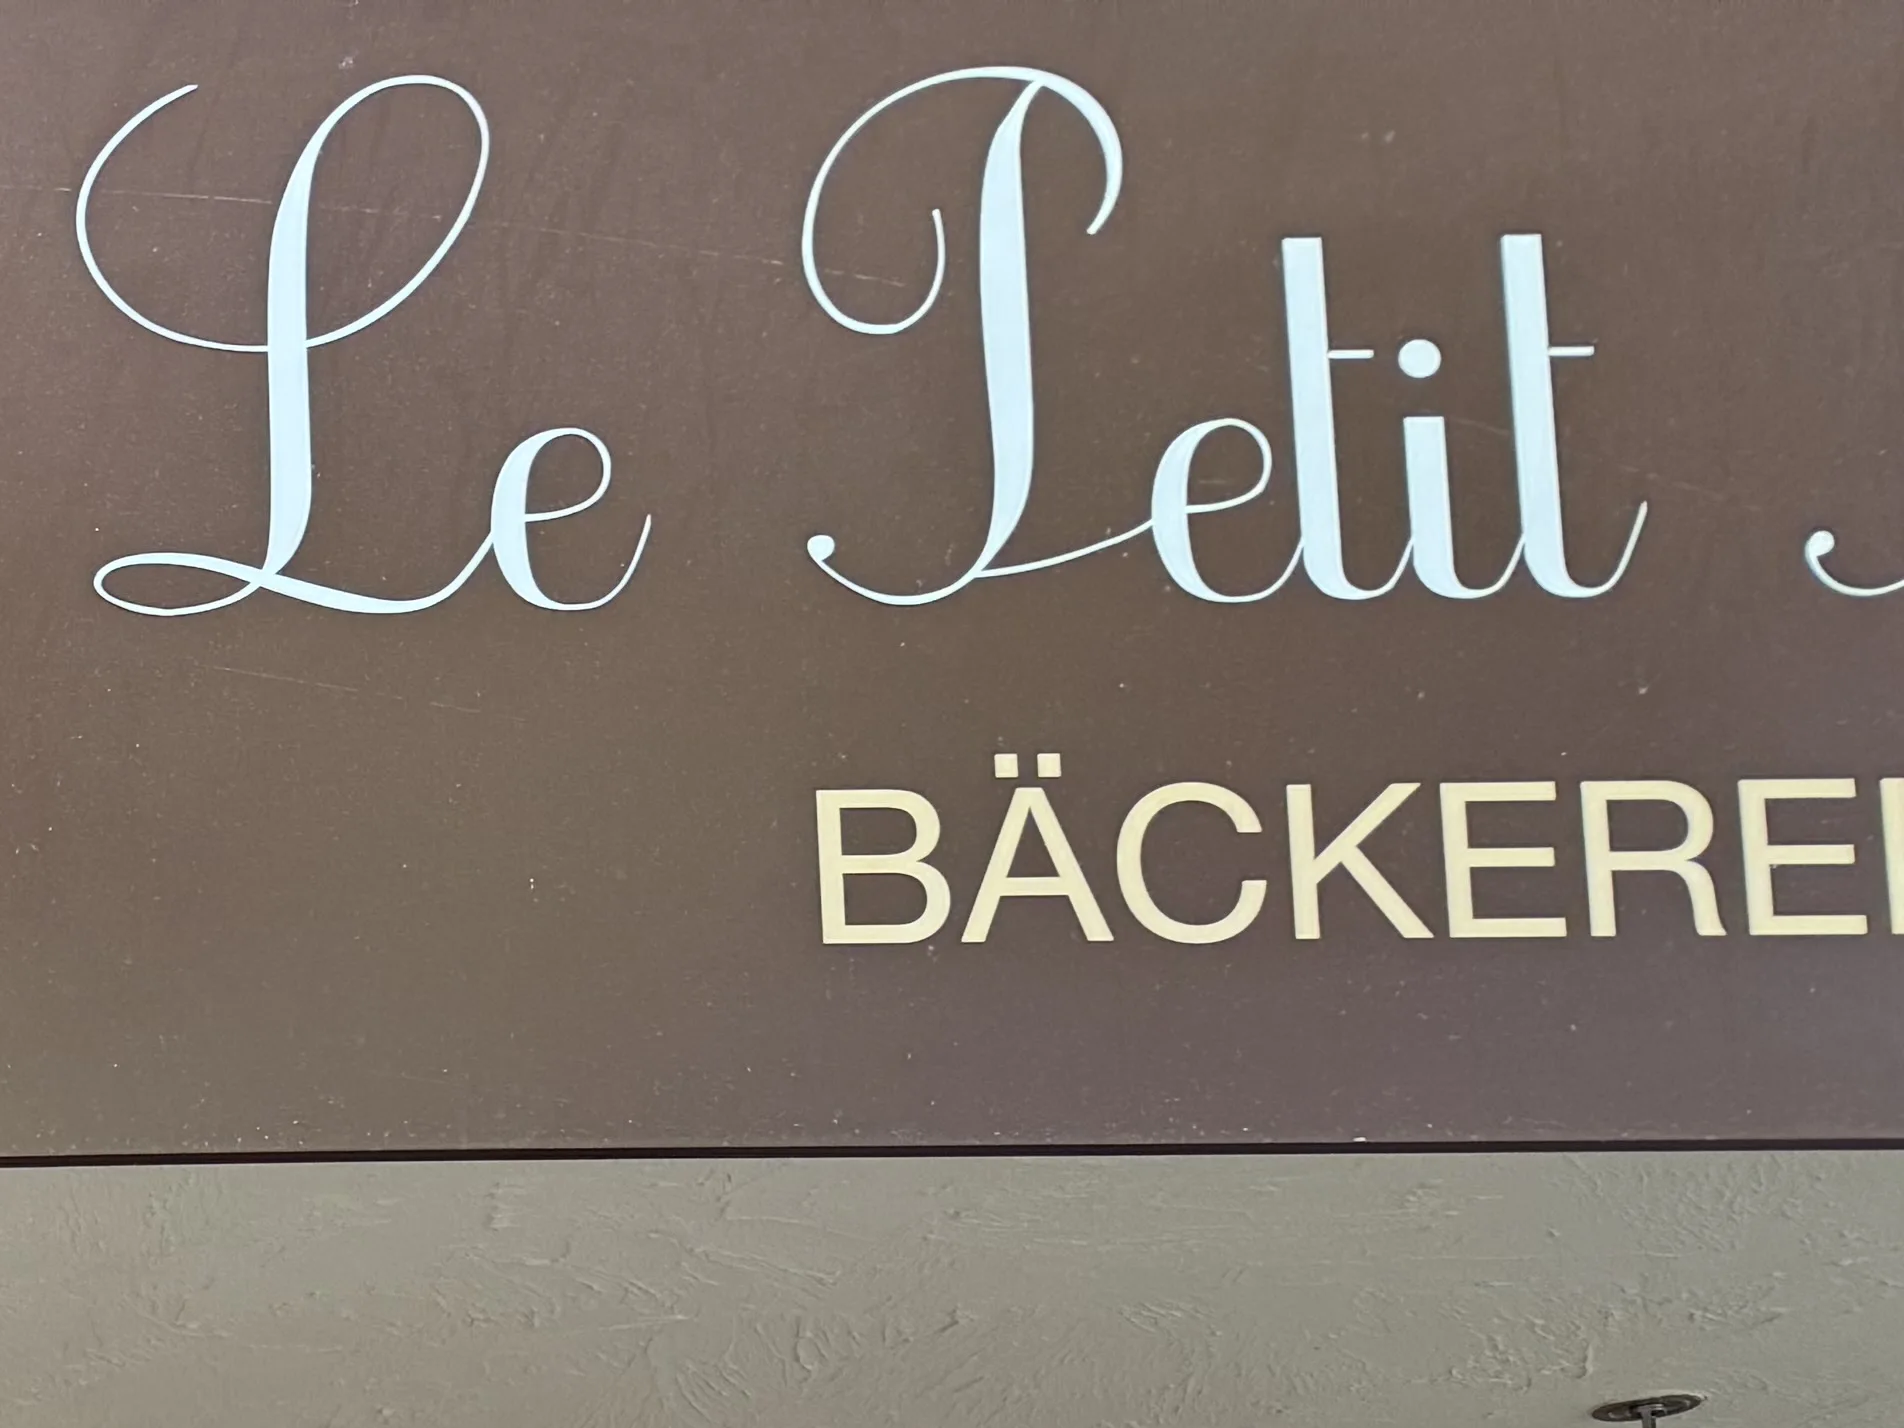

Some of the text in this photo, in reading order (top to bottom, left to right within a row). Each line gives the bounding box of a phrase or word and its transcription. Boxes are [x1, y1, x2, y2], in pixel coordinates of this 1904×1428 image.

[76, 64, 1647, 616] Le Petit
[815, 751, 1904, 947] BÄCKEREI
